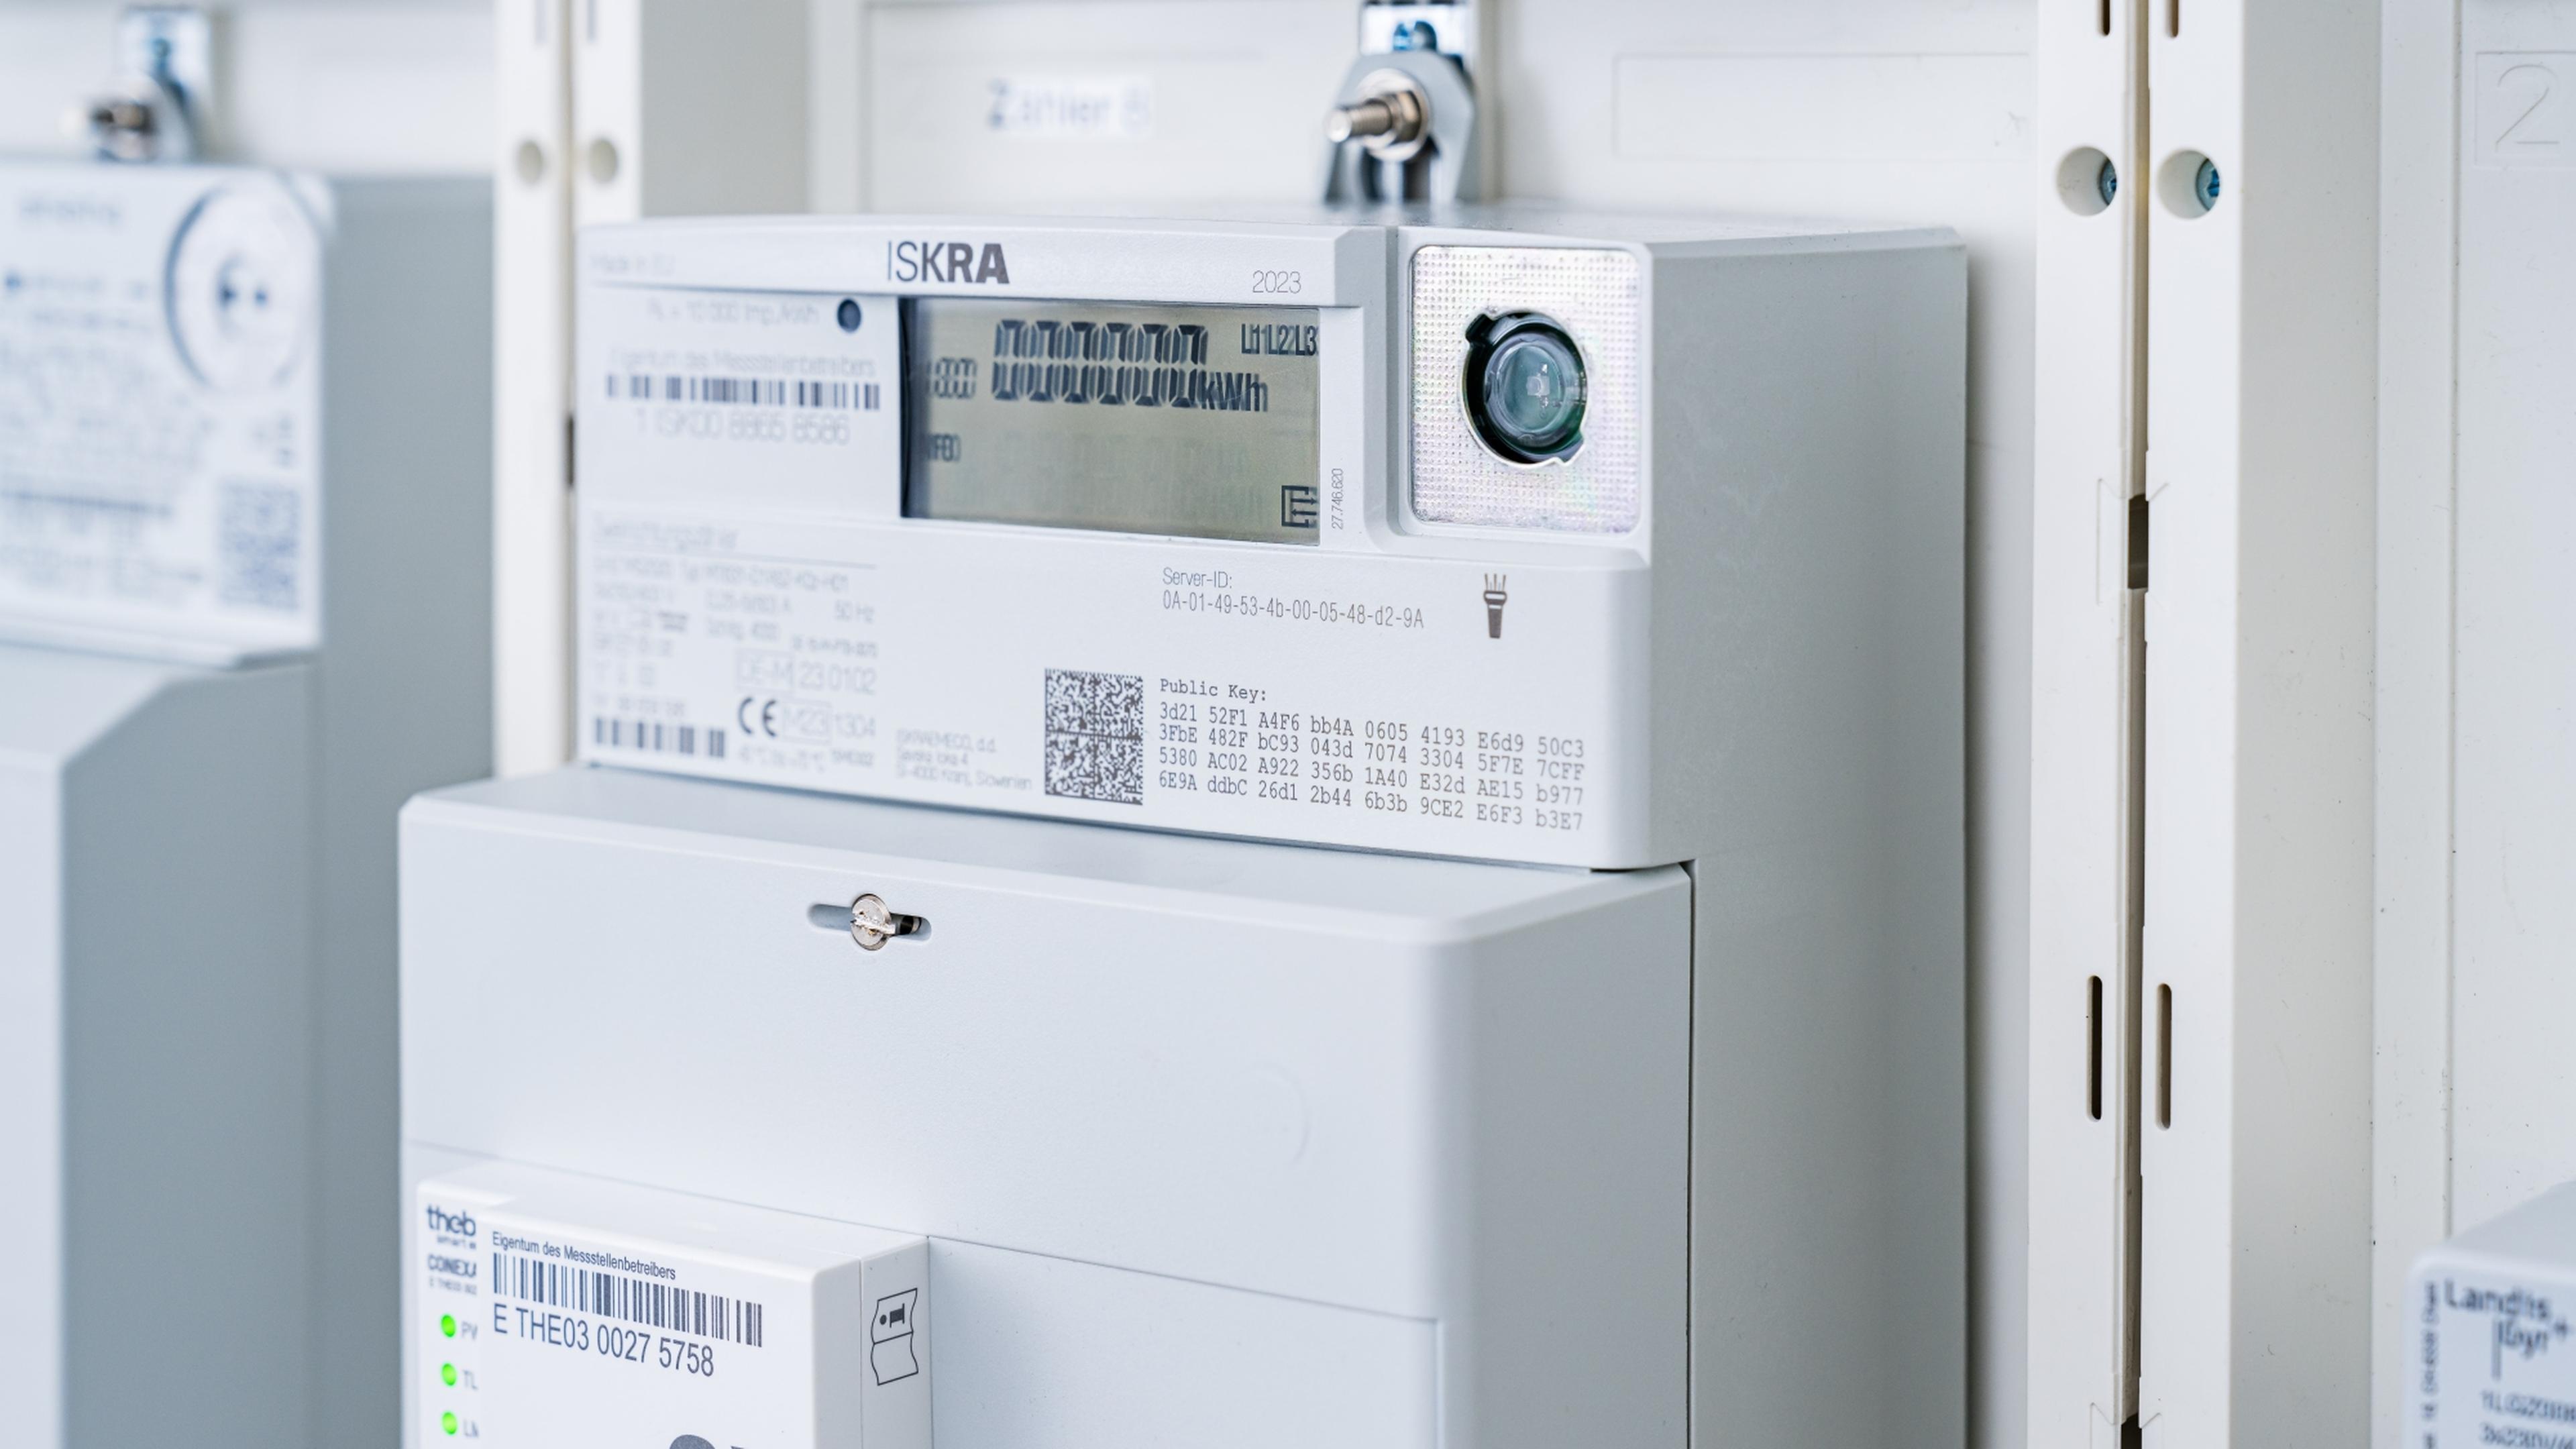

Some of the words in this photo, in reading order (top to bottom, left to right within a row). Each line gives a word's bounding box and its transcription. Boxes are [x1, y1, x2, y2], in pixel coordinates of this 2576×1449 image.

[888, 241, 1010, 284] ISKRA
[1252, 271, 1302, 294] 2023
[1199, 372, 1268, 412] kWh
[1330, 468, 1344, 530] 27.746.620
[1162, 568, 1233, 589] Server-ID:
[1162, 590, 1424, 629] 0A-01-49-53-4b-00-05-48-d2-9A
[1161, 678, 1218, 696] Public
[1229, 685, 1266, 704] Key:
[1160, 702, 1197, 721] 3d21
[1210, 706, 1247, 726] 52F1
[1258, 712, 1299, 731] A4F6
[1311, 716, 1354, 736] bb4A
[1365, 720, 1407, 741] 0605
[1421, 726, 1465, 747] 4193
[1477, 732, 1523, 752] E6d9
[1538, 736, 1584, 758] 50C3
[1160, 724, 1197, 743] 3FbE
[1209, 729, 1248, 747] 482F
[1311, 737, 1352, 758] 043d
[1364, 743, 1407, 763] 7074
[1420, 747, 1464, 769] 3304
[1478, 753, 1523, 775] 5F7E
[1537, 759, 1585, 781] 7CFF
[1159, 747, 1197, 766] 5380
[1208, 752, 1247, 771] AC02
[1258, 757, 1299, 777] A922
[1311, 761, 1352, 782] 356b
[1365, 767, 1407, 788] 1A40
[1419, 773, 1465, 794] E32d
[1477, 779, 1523, 800] AE15
[1536, 784, 1583, 806] b977
[1159, 770, 1197, 790] 6E9A
[1258, 780, 1297, 800] 26d1
[1310, 786, 1351, 806] 2b44
[1364, 791, 1407, 812] 6b3b
[1420, 796, 1464, 818] 9CE2
[1477, 804, 1523, 824] E6F3
[1536, 808, 1582, 830] b3E7
[493, 1231, 539, 1253] Eigentum
[543, 1240, 561, 1258] des
[564, 1245, 676, 1280] Messstellenbetreibers
[494, 1303, 508, 1334] E
[515, 1306, 589, 1350] THE03
[598, 1324, 651, 1363] 0027
[659, 1336, 714, 1377] 5758
